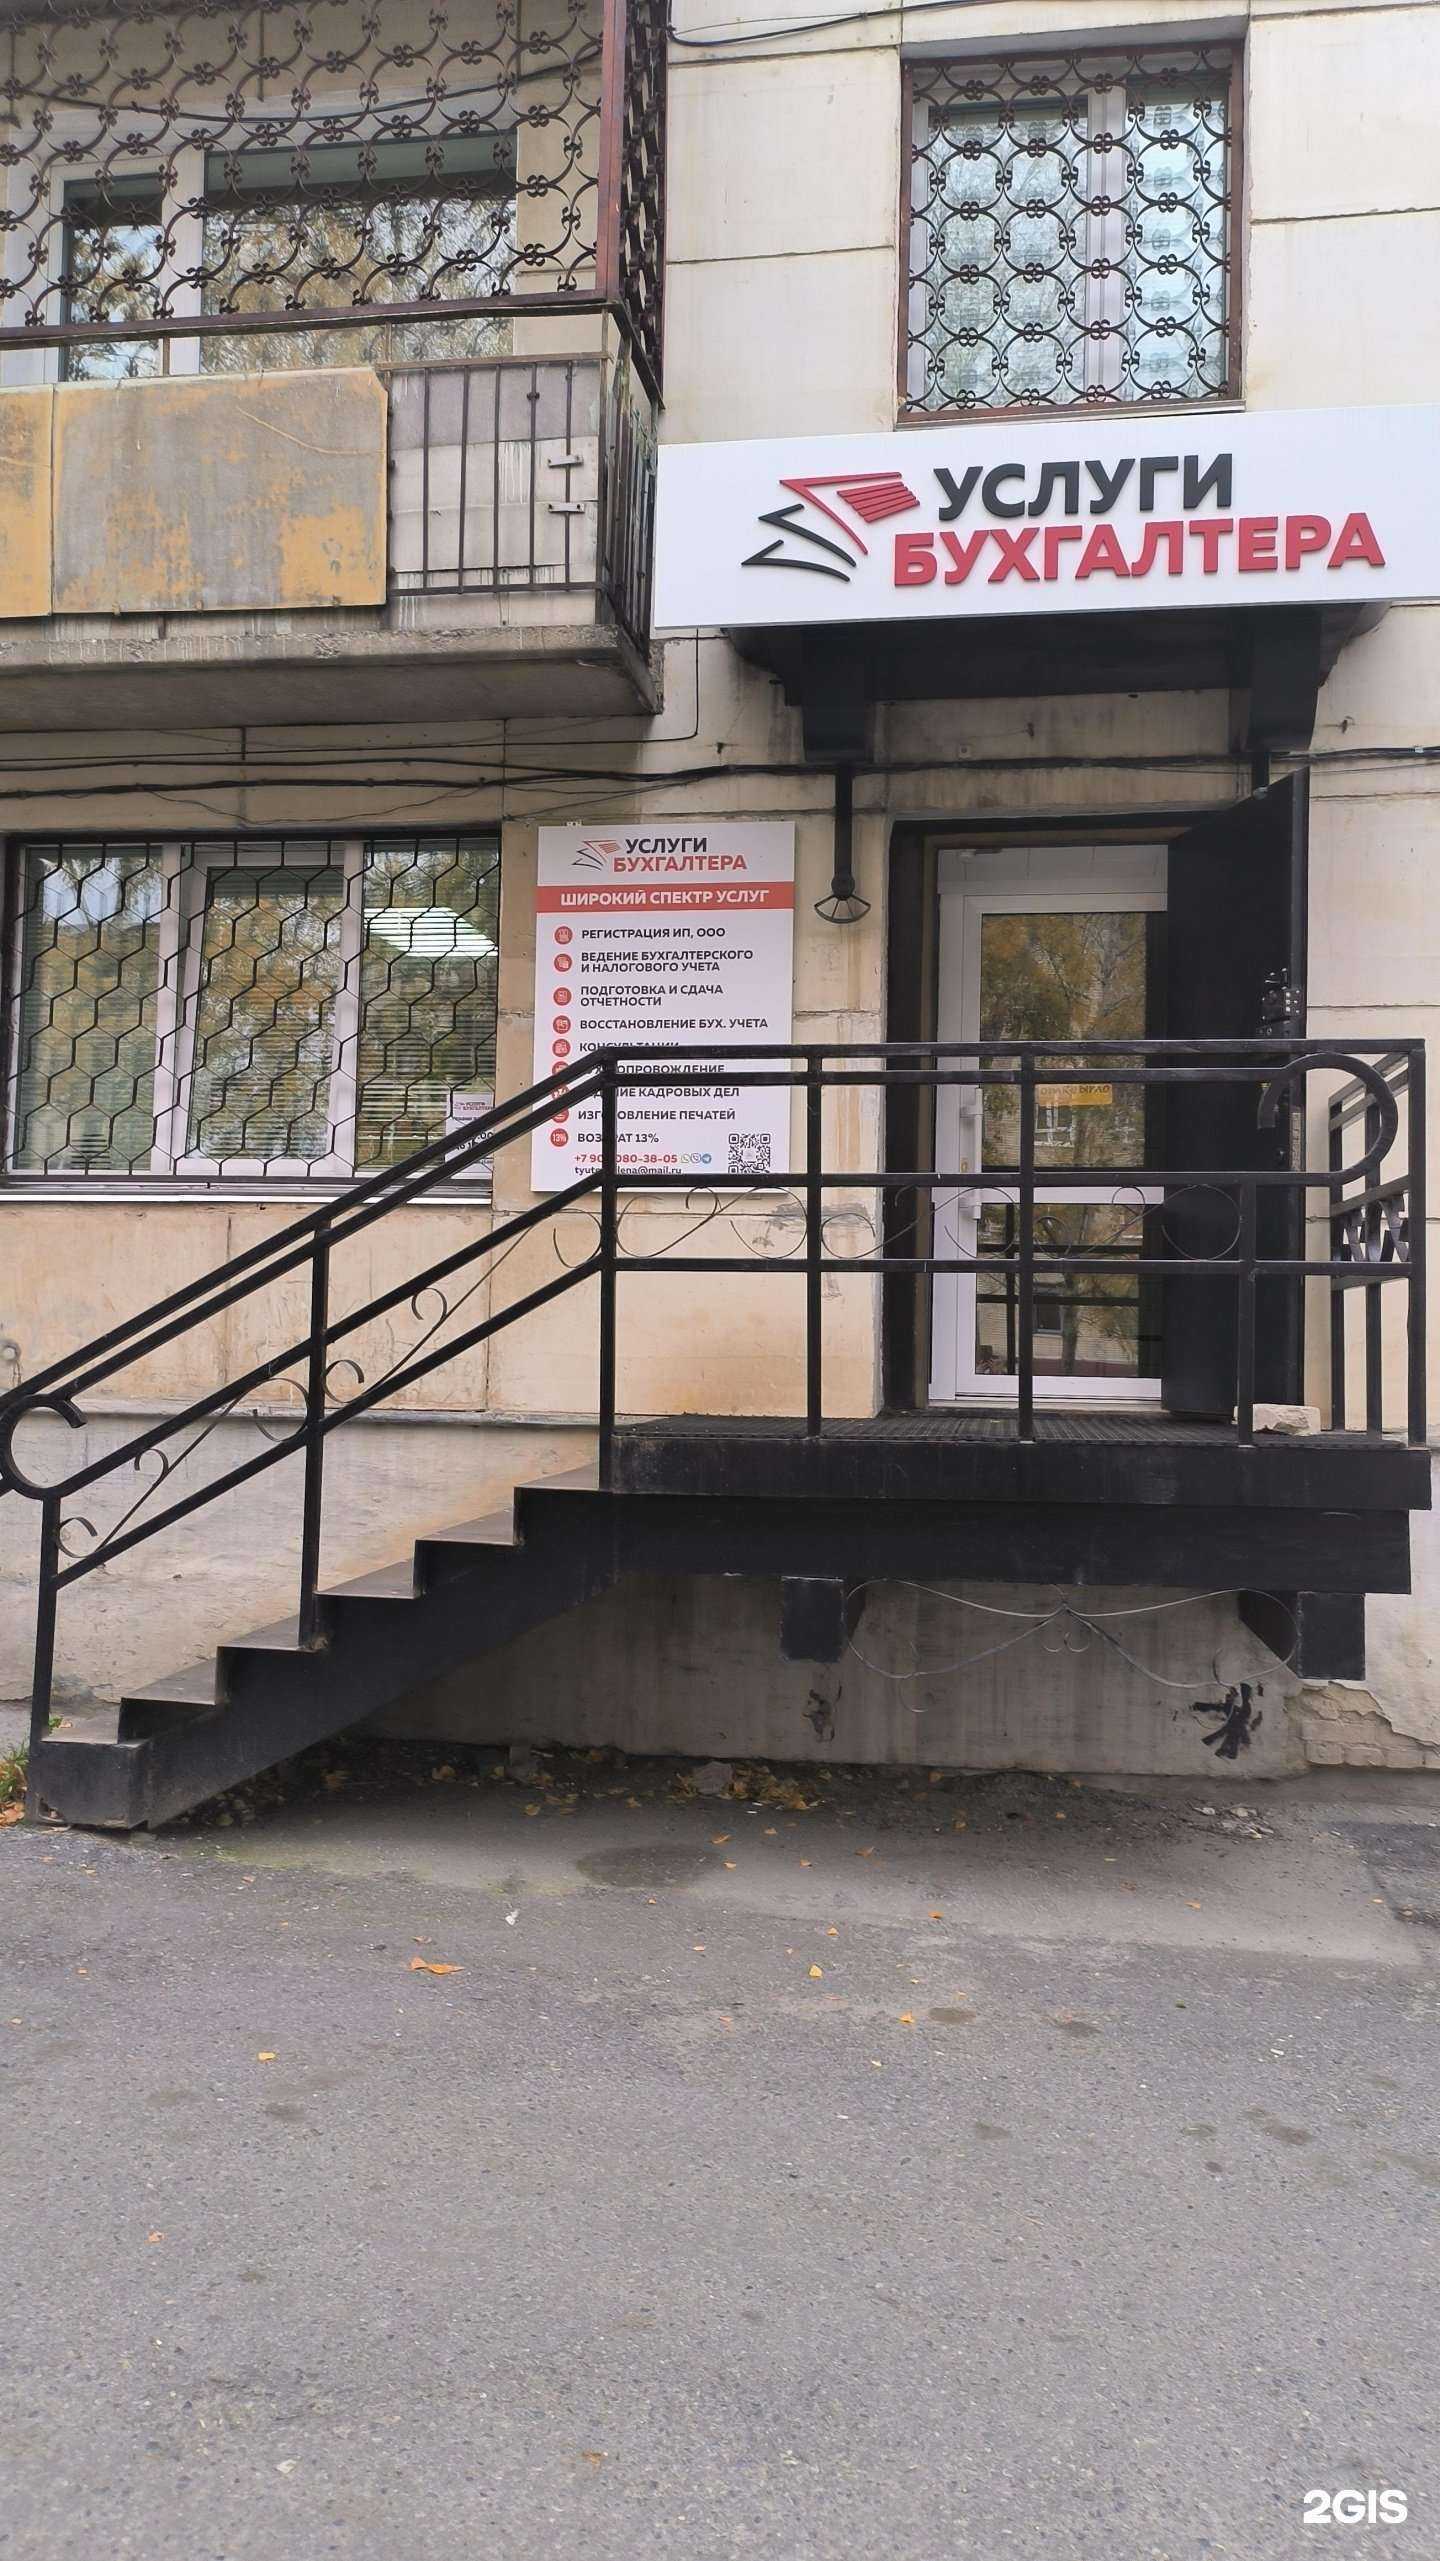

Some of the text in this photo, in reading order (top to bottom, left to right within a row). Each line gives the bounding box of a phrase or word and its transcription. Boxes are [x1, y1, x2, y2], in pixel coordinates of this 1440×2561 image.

[932, 453, 1233, 521] УСЛУГИ
[893, 512, 1386, 588] БУХГАЛТЕРА
[625, 837, 707, 854] УСЛУГИ
[613, 855, 747, 873] БУХГАЛТЕРА
[561, 889, 769, 906] ШИРОКИЙ СПЕКТР УСЛУГ
[581, 927, 726, 940] РЕГИСТРАЦИЯ ИП, ООО
[581, 949, 753, 963] ВЕДЕНИЕ БУХГАЛТЕРСКОГО
[581, 961, 720, 973] И НАЛОГОВОГО УЧЕТА
[580, 984, 723, 997] ПОДГОТОВКА И СДАЧА
[580, 996, 662, 1007] ОТЧЕТНОСТИ
[580, 1017, 768, 1030] ВОССТАНОВЛЕНИЕ БУХ. УЧЕТА
[614, 1064, 725, 1074] ОПРОВОЖДЕНИЕ
[639, 1087, 711, 1098] КАДРОВЫХ
[713, 1087, 740, 1099] ДЕЛ
[578, 1108, 736, 1120] ИЗГОВЛЕНИЕ ПЕЧАТЕЙ
[577, 1133, 660, 1143] ВОЗАТ 13%
[575, 1154, 587, 1163] +7
